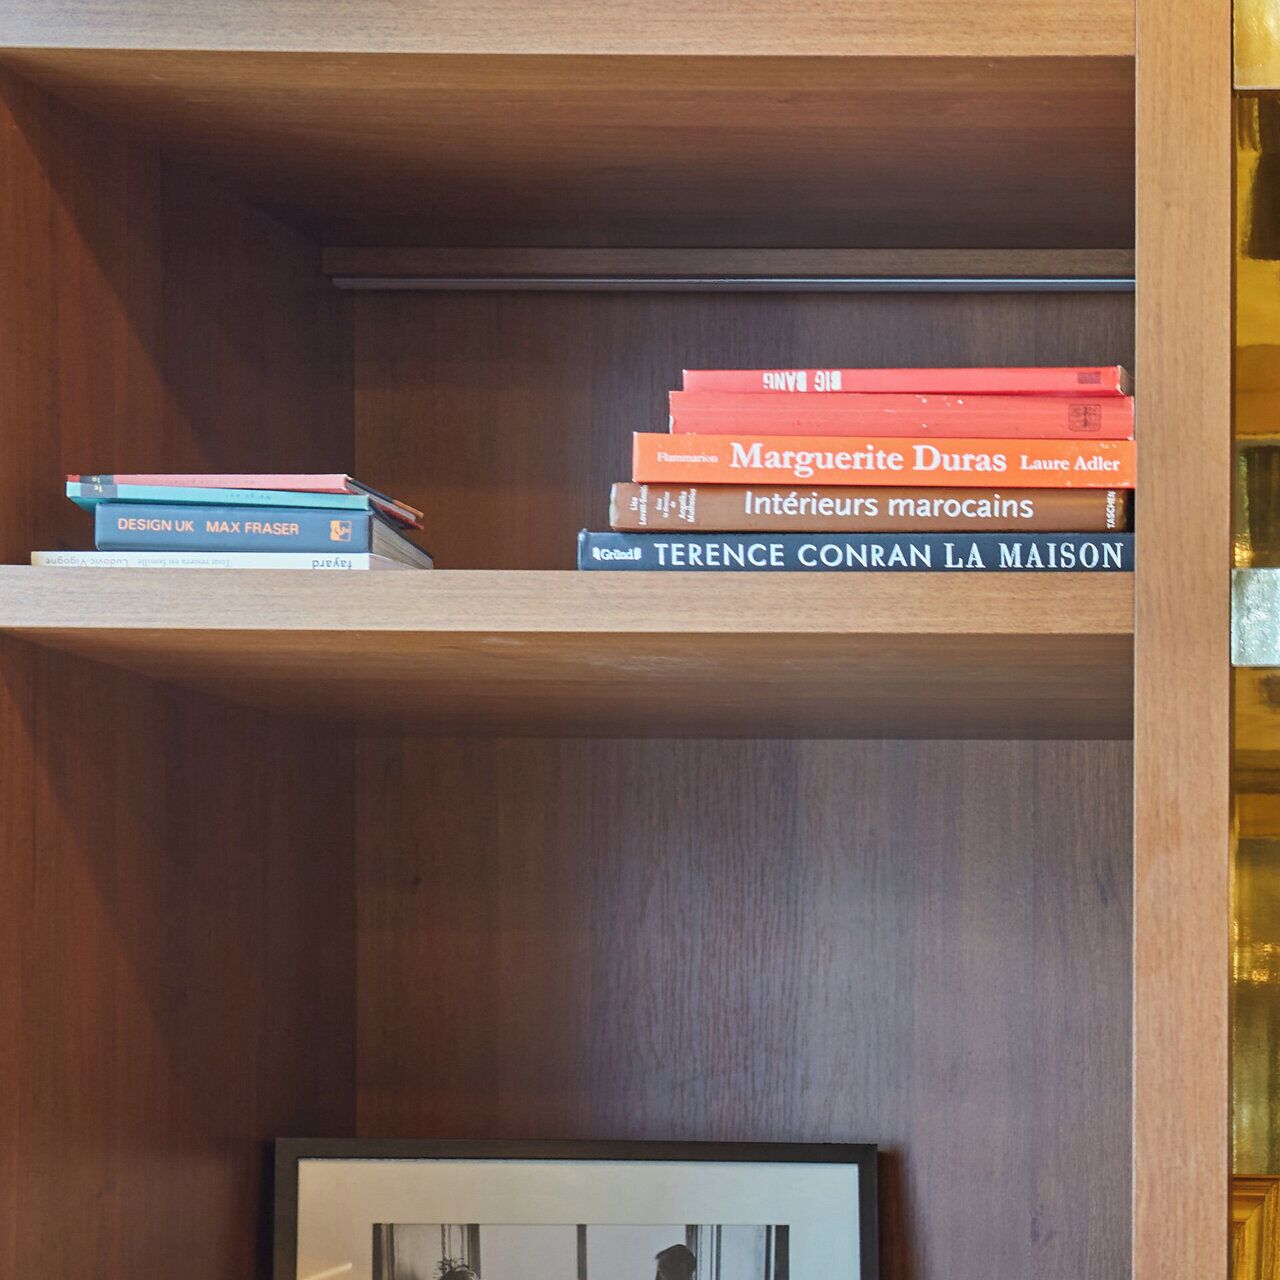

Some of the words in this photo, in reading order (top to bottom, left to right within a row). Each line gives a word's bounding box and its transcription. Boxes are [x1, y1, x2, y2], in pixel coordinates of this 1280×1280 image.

[763, 371, 807, 392] BANG
[814, 371, 842, 391] BIG
[657, 451, 719, 463] Flammarion
[729, 442, 905, 478] Marguerite
[912, 444, 1007, 472] Duras
[1019, 455, 1070, 470] Laure
[1074, 455, 1121, 472] Adler
[744, 490, 878, 515] Intérieurs
[888, 494, 1034, 519] marocains
[1106, 490, 1116, 529] TASCHEN
[118, 517, 171, 532] DESIGN
[175, 518, 194, 532] UK
[206, 520, 240, 534] MAX
[244, 522, 299, 536] FRASER
[312, 556, 352, 570] fayard
[653, 543, 785, 567] TERENCE
[797, 543, 931, 568] CONRAN
[943, 543, 986, 568] LA
[999, 542, 1124, 568] MAISON
